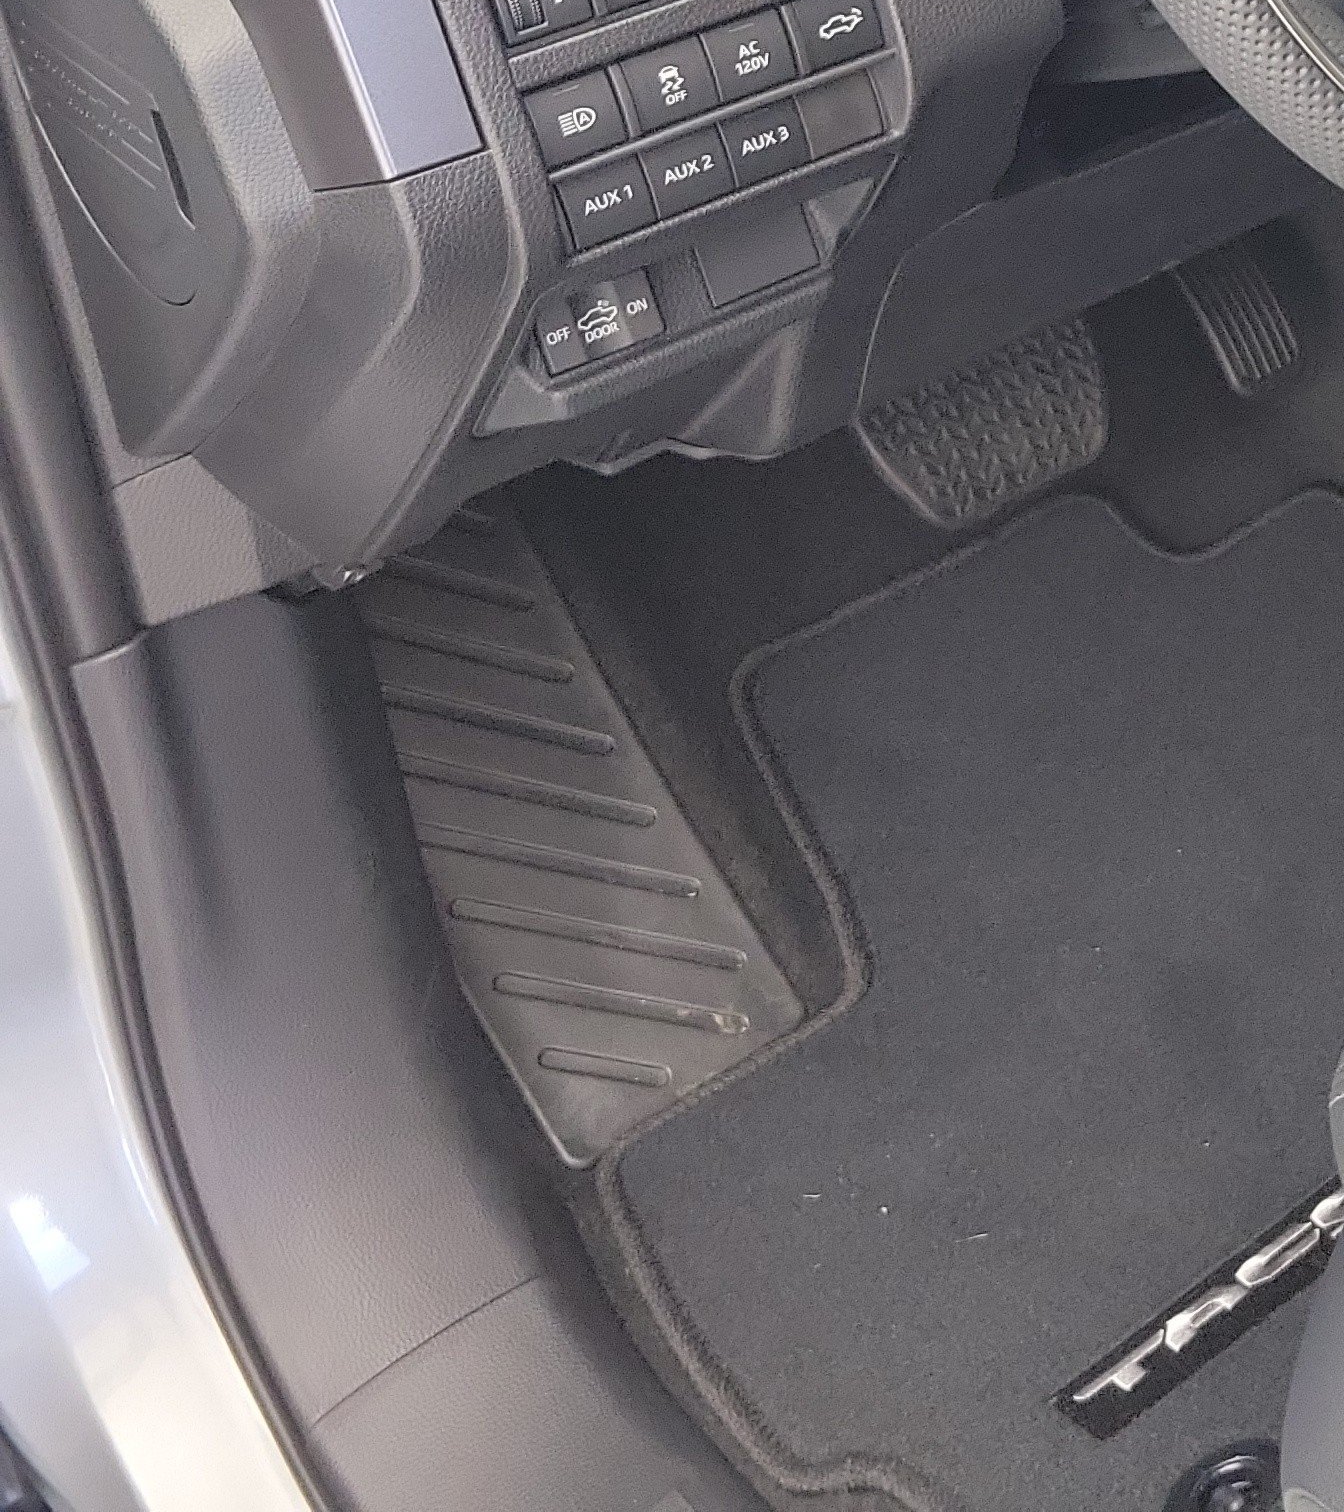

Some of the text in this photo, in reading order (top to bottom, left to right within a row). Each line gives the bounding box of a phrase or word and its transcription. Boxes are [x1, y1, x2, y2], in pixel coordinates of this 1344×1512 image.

[738, 40, 762, 60] AC
[734, 52, 770, 76] 120V
[665, 89, 688, 106] OFF
[741, 126, 790, 156] AUX 3
[663, 154, 715, 186] AUX 2
[584, 184, 634, 216] AUX 1
[626, 297, 649, 315] ON
[546, 326, 571, 345] OFF
[584, 321, 620, 344] DOOR
